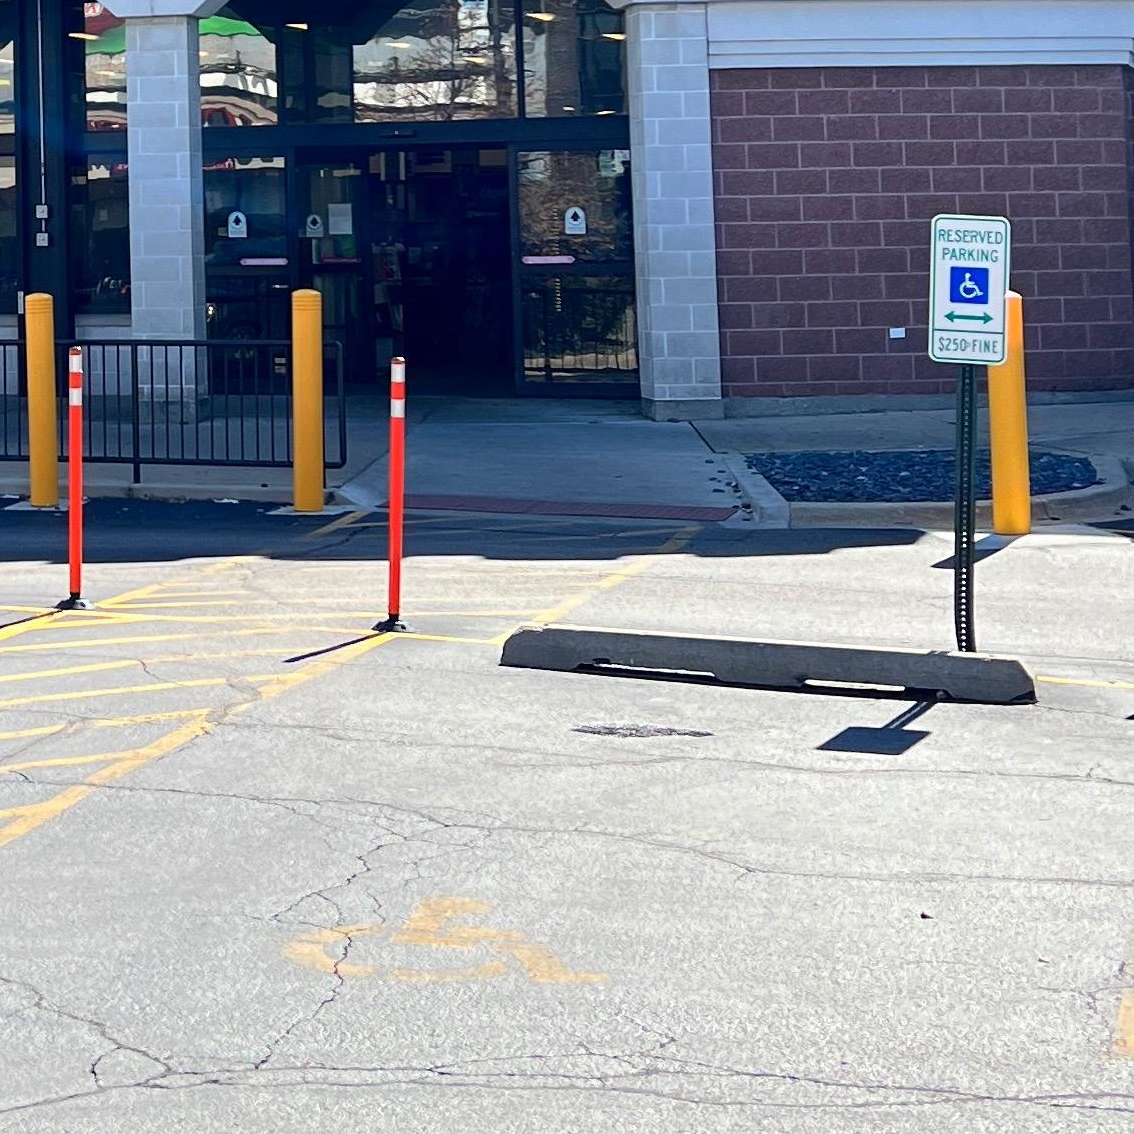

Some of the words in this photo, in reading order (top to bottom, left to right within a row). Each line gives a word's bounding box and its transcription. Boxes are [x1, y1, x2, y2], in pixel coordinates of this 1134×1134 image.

[938, 229, 1003, 245] RESERVED
[942, 248, 998, 263] PARKING
[972, 339, 998, 354] FINE
